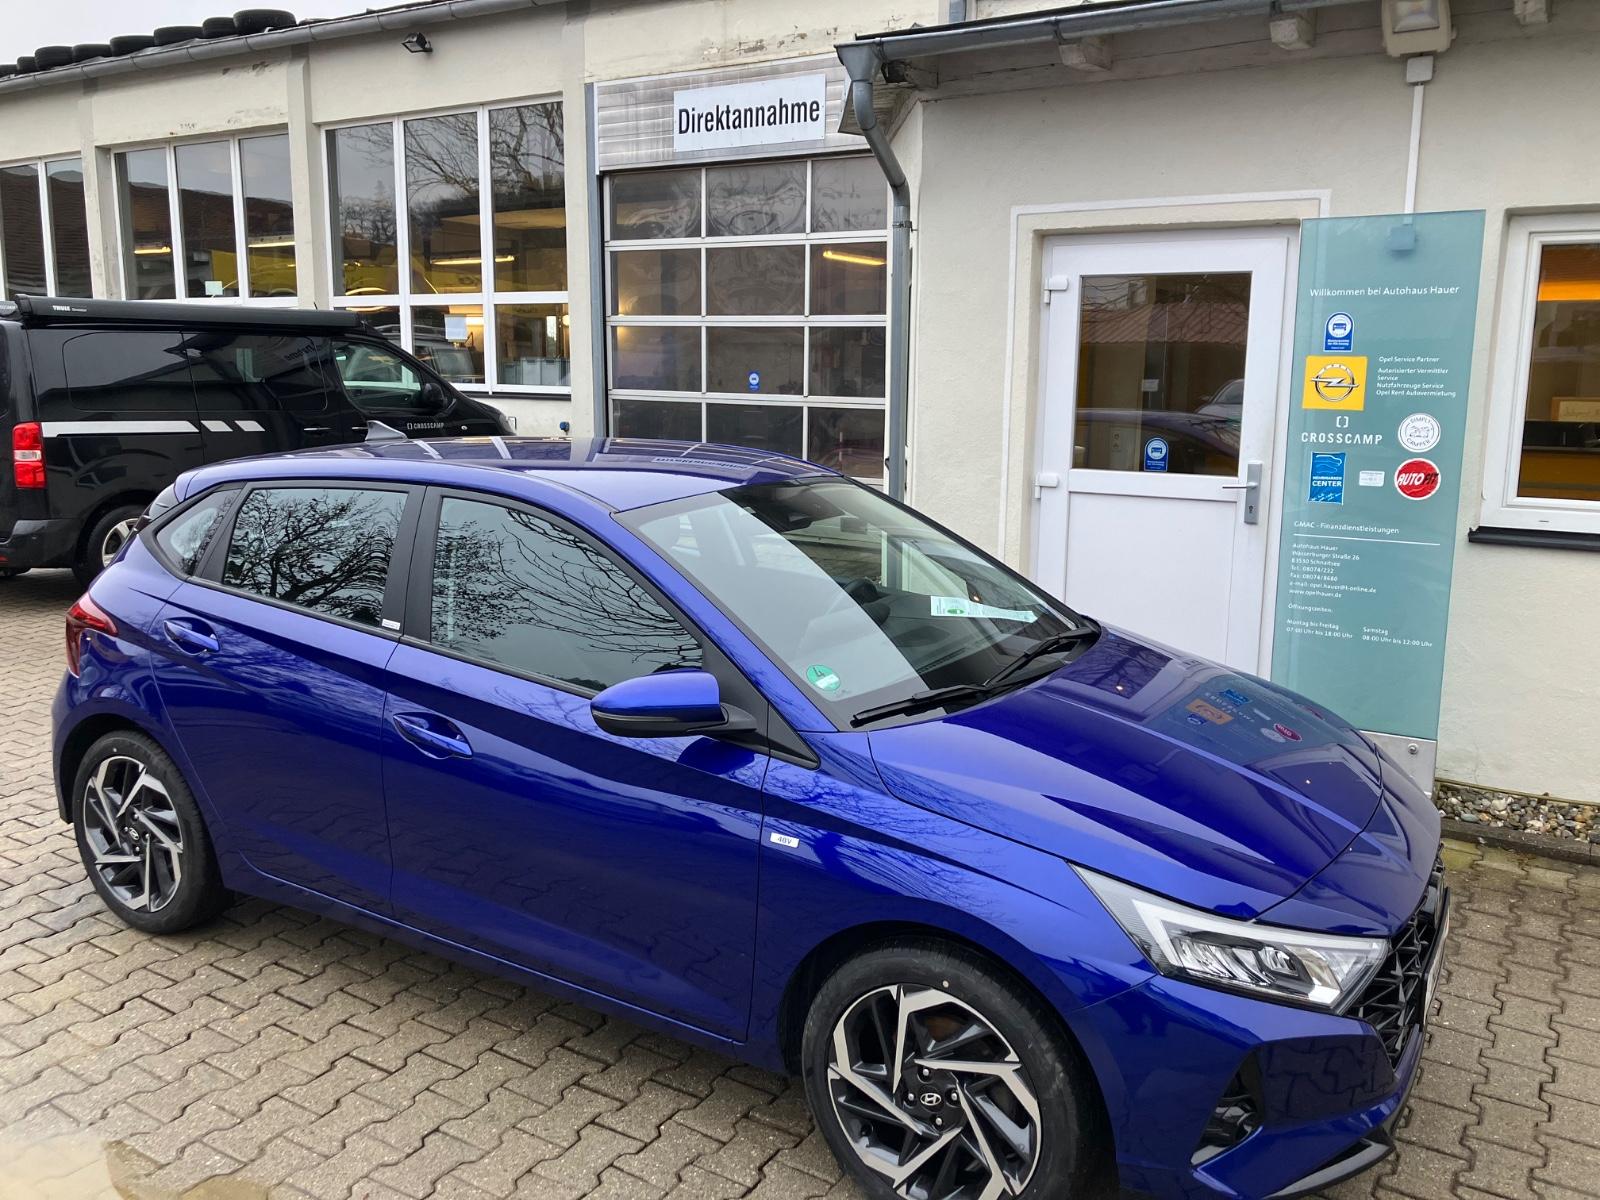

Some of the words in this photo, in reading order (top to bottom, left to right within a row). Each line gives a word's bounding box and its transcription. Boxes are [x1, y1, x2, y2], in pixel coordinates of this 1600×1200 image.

[678, 97, 820, 135] Direktannahme
[1309, 287, 1365, 297] Willkommen
[1367, 286, 1381, 296] bei
[1383, 286, 1428, 296] Autohaus
[1430, 285, 1460, 295] Hauer
[1376, 382, 1421, 390] Nutzfahrzeuge
[1406, 390, 1456, 398] Autovermietung
[1301, 432, 1383, 445] CROSSCAMP
[1293, 520, 1315, 529] GMAC
[1320, 522, 1400, 535] Finanzdienstleistungen
[1286, 619, 1309, 628] Montag
[1319, 622, 1339, 631] Freitag
[1363, 626, 1389, 636] Samstag
